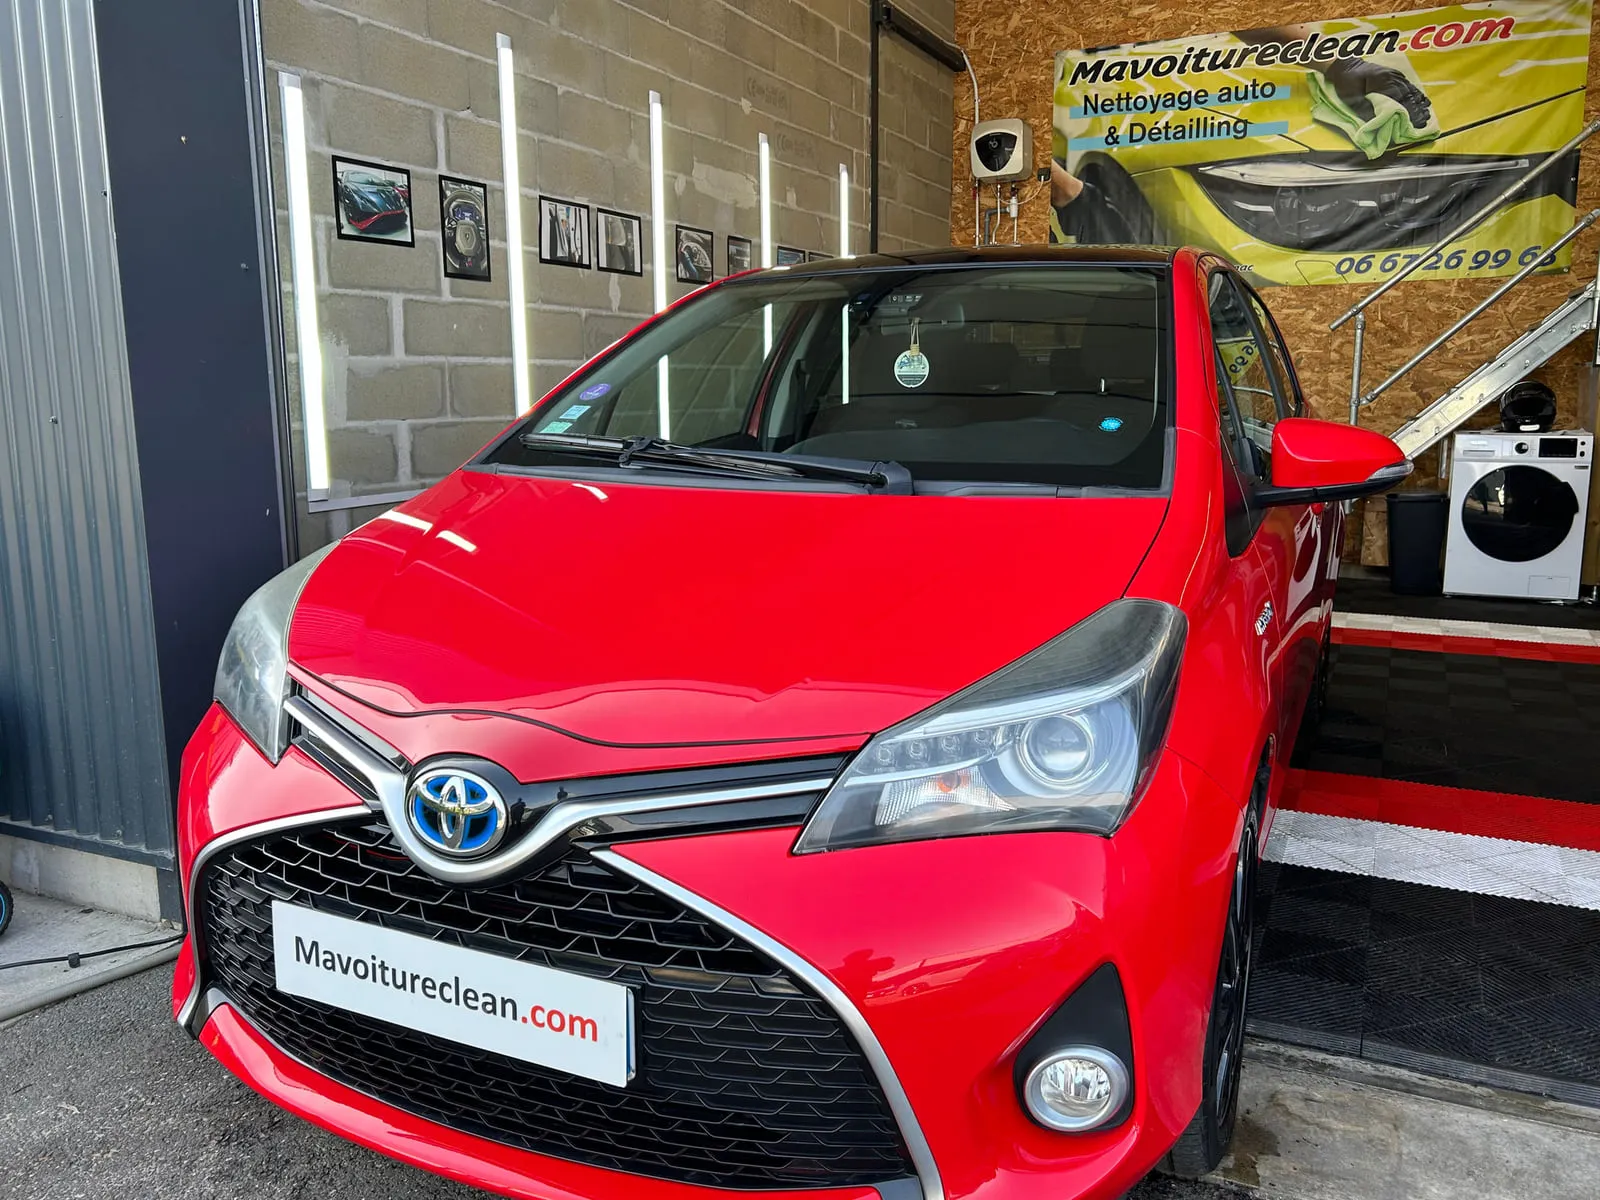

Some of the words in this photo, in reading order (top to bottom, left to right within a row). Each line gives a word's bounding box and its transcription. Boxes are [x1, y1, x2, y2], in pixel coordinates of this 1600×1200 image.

[1068, 17, 1515, 86] Mavoitureclean.com
[1083, 90, 1209, 115] Nettoyage
[1217, 79, 1277, 103] auto
[1104, 126, 1120, 146] &
[1128, 116, 1248, 144] Détailling
[1335, 254, 1375, 275] 06
[1421, 249, 1466, 270] 26
[1468, 249, 1511, 270] 99
[294, 935, 598, 1042] Mavoitureclean.com
